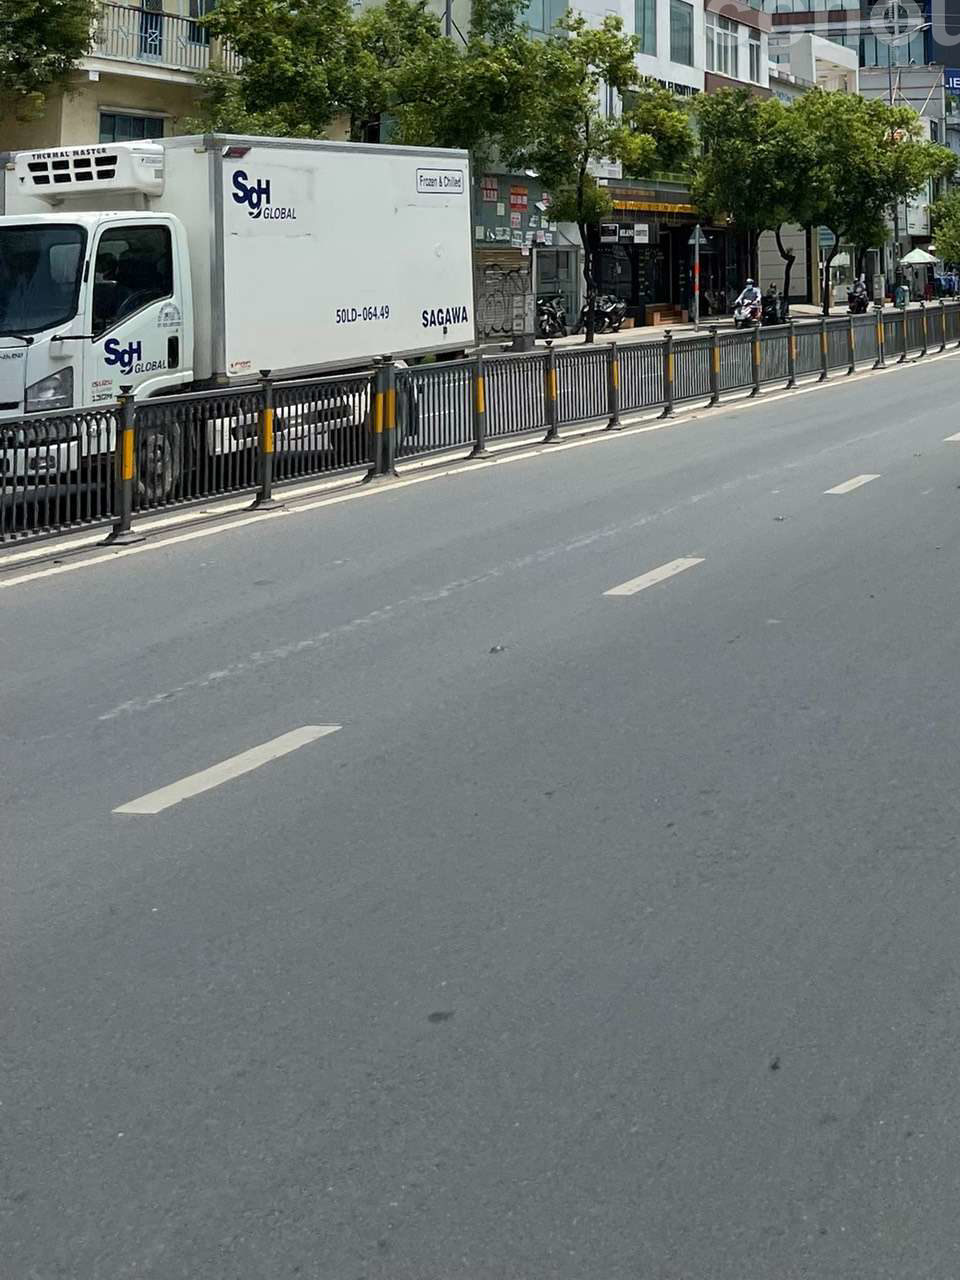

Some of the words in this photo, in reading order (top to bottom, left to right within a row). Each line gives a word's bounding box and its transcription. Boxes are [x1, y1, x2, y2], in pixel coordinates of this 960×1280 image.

[32, 151, 70, 160] THERMAL
[72, 147, 107, 157] MASTER
[263, 207, 297, 220] GLOBAL
[422, 305, 468, 328] SAGAWA
[134, 359, 167, 374] GLOBAL
